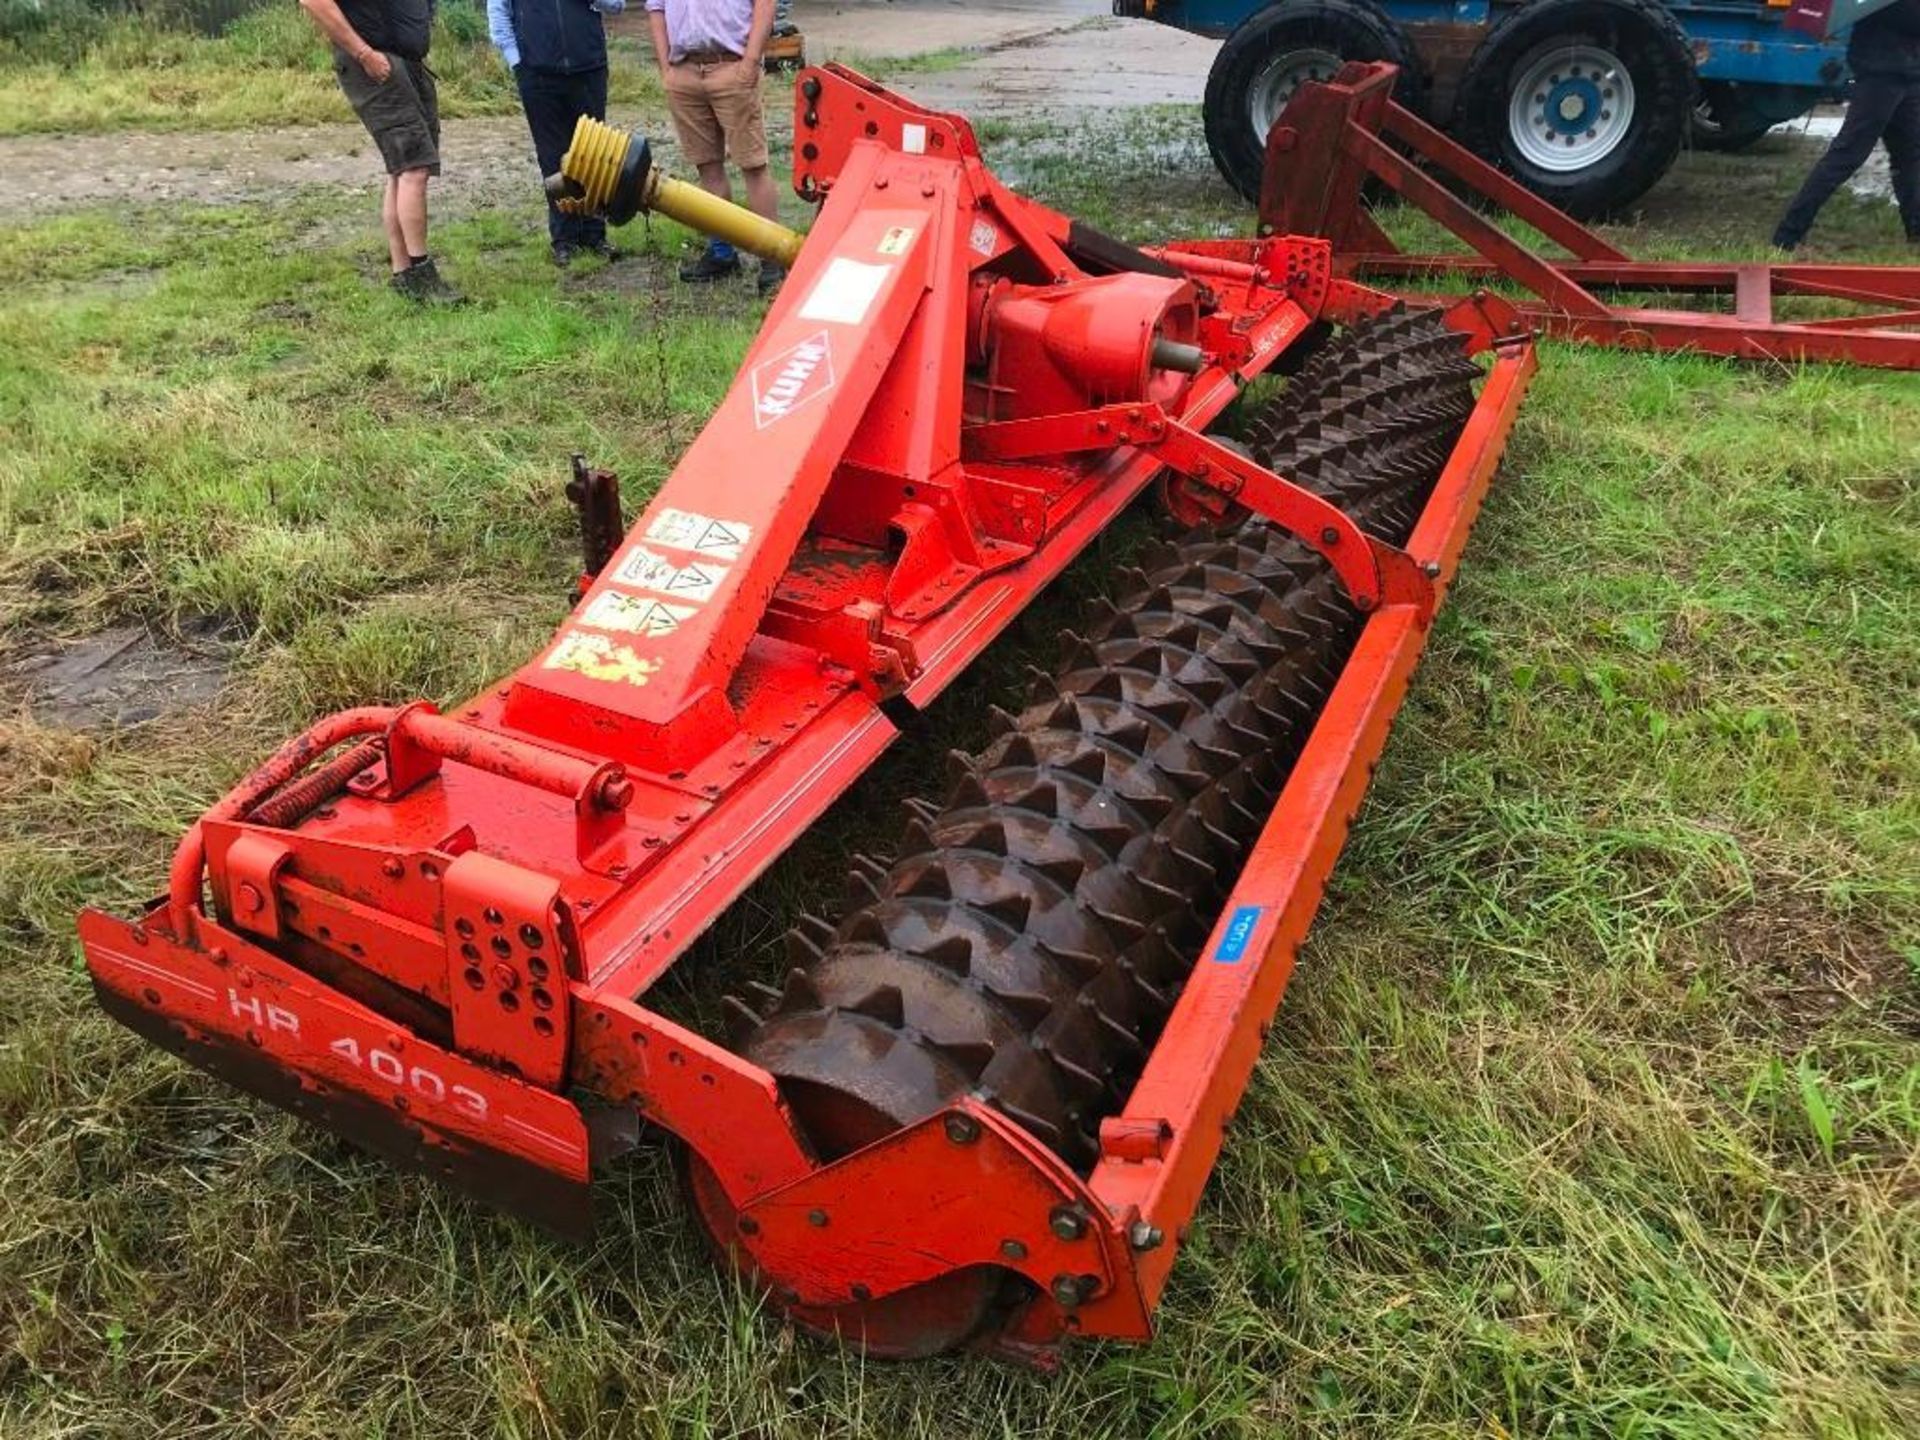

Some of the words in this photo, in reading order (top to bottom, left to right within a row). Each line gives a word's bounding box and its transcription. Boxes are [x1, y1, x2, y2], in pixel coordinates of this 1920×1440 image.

[759, 343, 827, 415] KUHN
[228, 988, 300, 1037] HR
[330, 1037, 488, 1121] 4003
